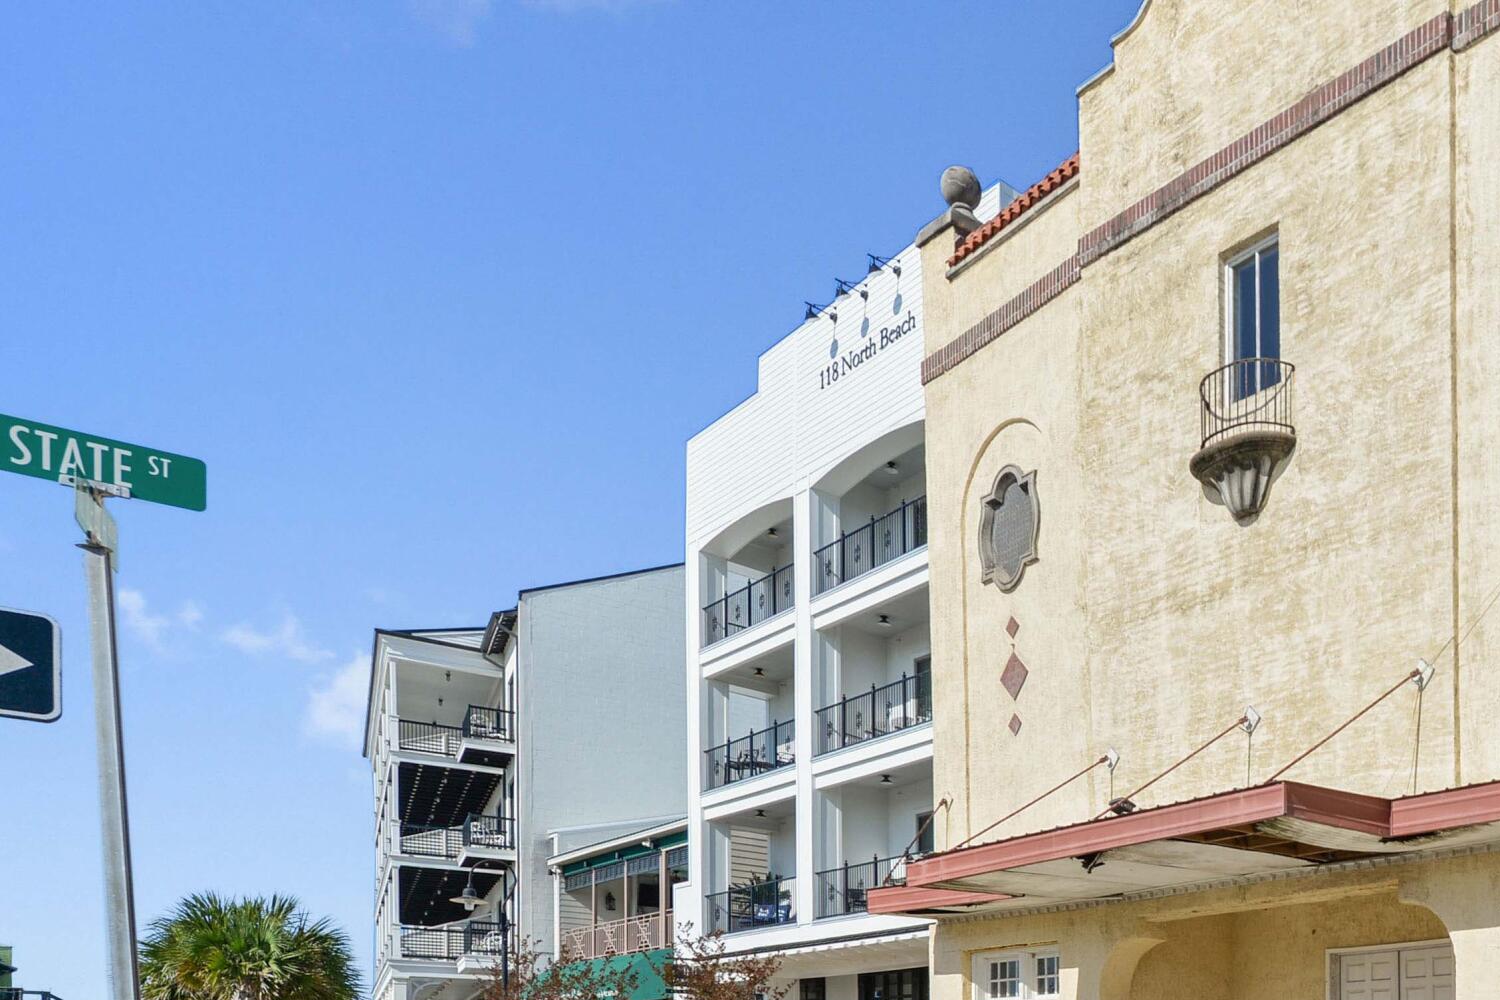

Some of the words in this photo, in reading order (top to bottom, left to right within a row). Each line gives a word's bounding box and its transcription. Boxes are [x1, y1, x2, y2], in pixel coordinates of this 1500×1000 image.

[819, 361, 839, 390] 118
[841, 337, 877, 376] North
[880, 310, 916, 350] Beach
[9, 425, 133, 489] STATE
[148, 456, 172, 479] ST
